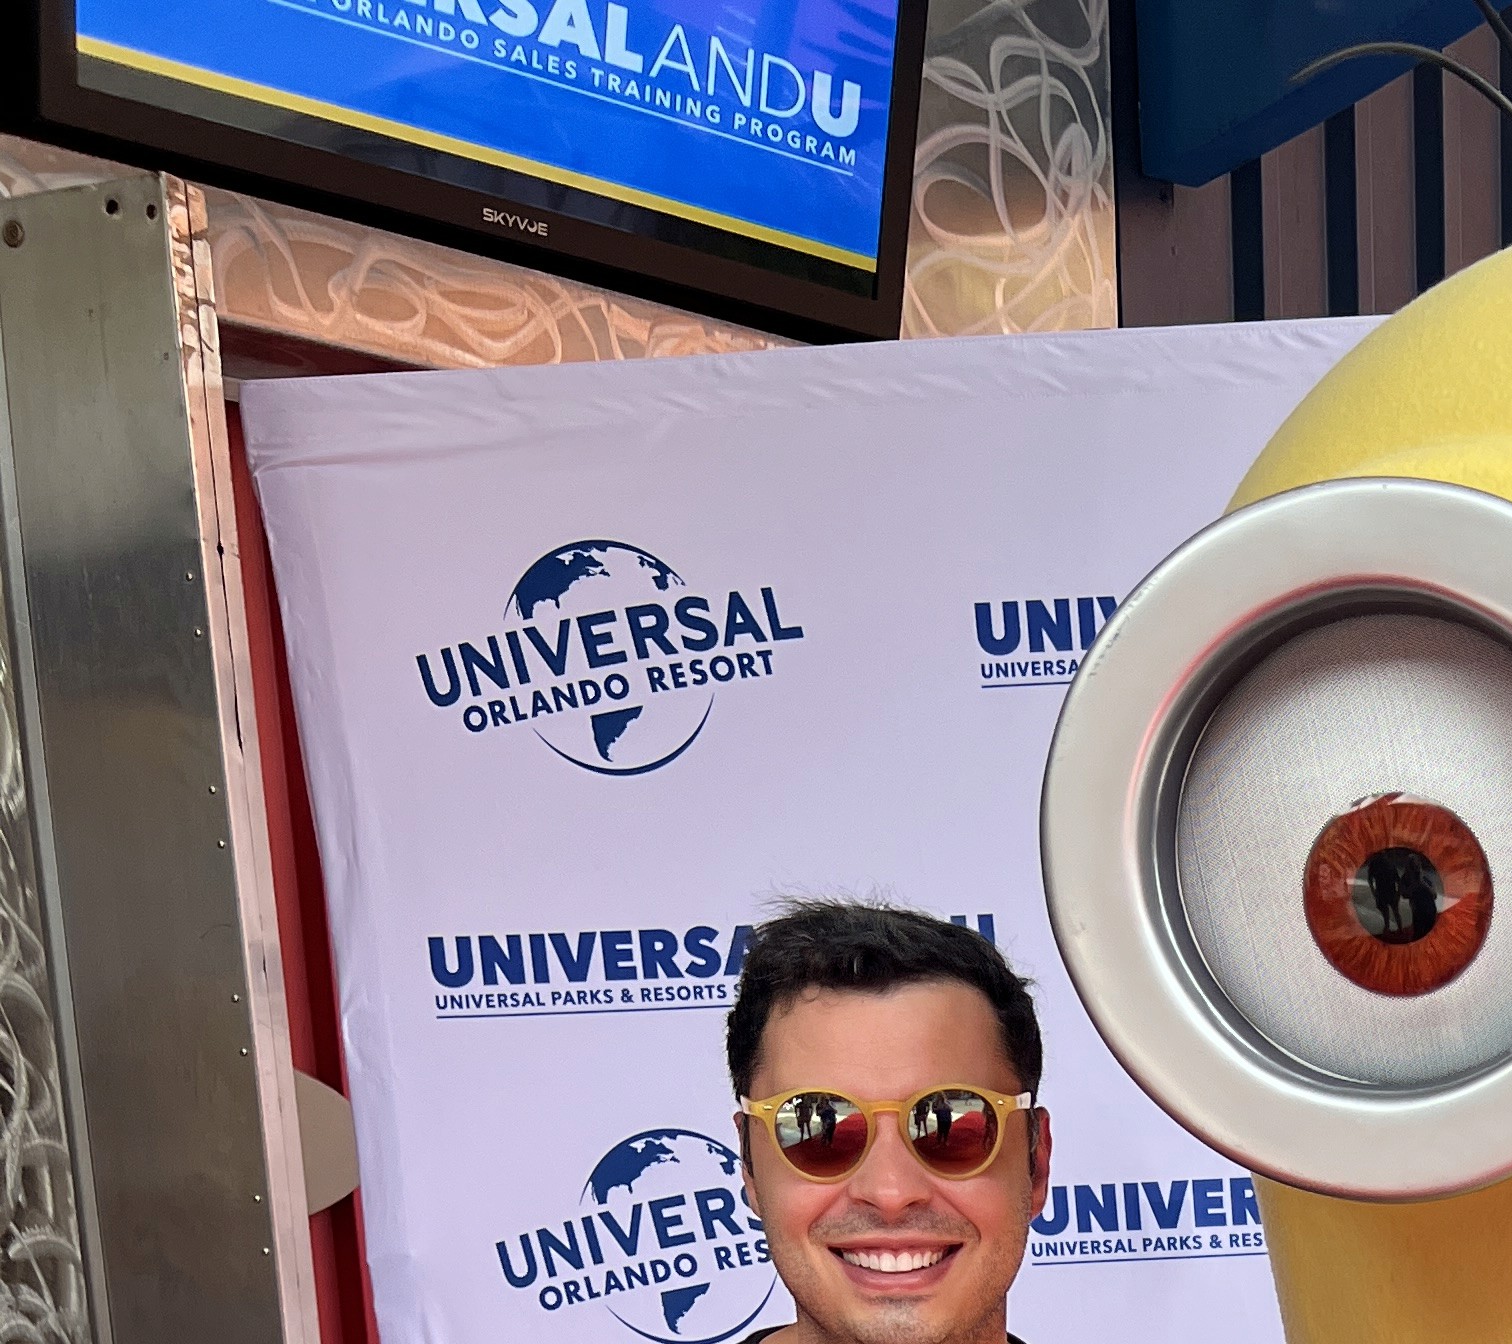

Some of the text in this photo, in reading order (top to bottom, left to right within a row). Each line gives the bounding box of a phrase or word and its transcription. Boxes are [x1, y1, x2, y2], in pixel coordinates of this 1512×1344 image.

[493, 38, 578, 79] SALES
[590, 67, 721, 124] TRAINING
[733, 113, 856, 166] PROGRAM
[416, 587, 804, 707] UNIVERSAL
[463, 649, 773, 732] ORLANDO RESORT
[435, 991, 546, 1010] UNIVERSAL
[551, 989, 614, 1006] PARKS
[620, 988, 635, 1003] &
[641, 984, 727, 1003] RESORTS
[1031, 1238, 1137, 1257] UNIVERSAL
[1142, 1235, 1202, 1253] PARKS
[1209, 1234, 1222, 1249] &
[539, 1253, 698, 1311] ORLANDO
